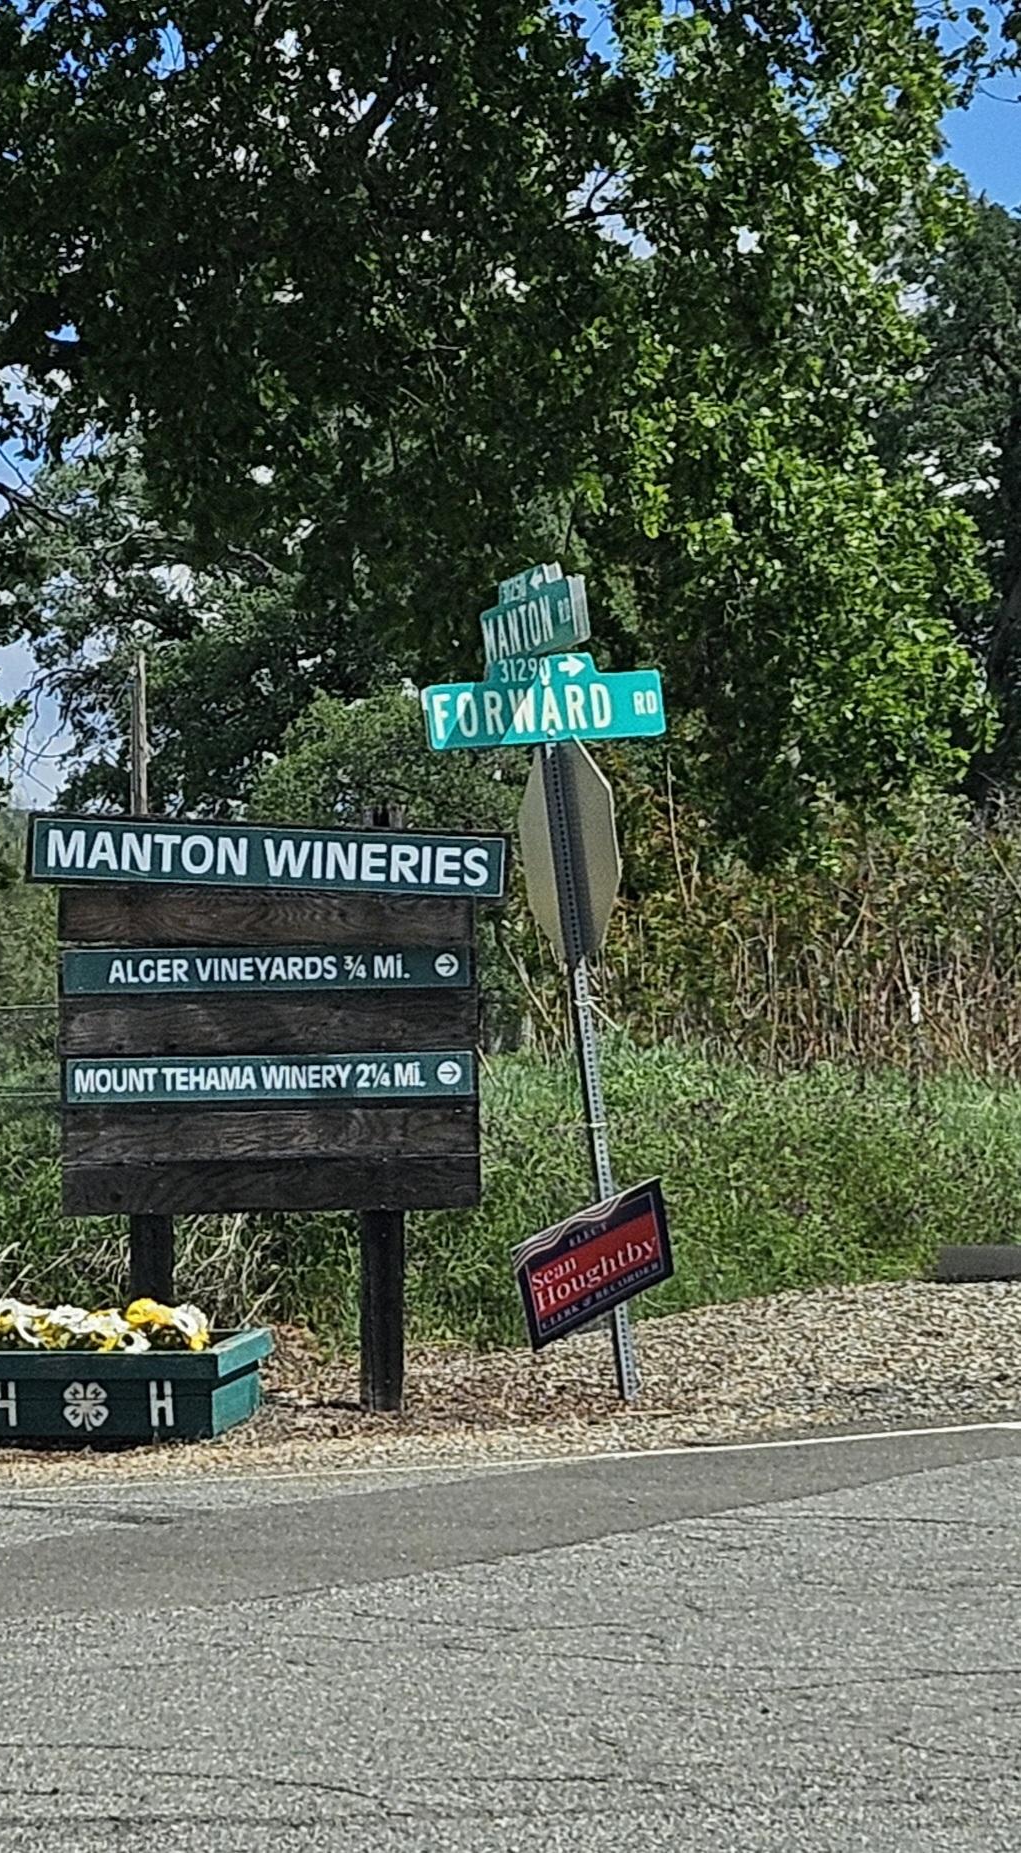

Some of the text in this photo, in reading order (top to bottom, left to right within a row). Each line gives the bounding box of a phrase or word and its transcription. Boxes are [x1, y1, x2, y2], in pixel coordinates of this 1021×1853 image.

[482, 596, 554, 663] MANTON
[432, 683, 658, 740] FORWARD RD
[46, 828, 490, 888] MANTON WINERIES
[108, 957, 190, 985] ALGER
[195, 954, 338, 982] VINEYARDS
[73, 1066, 159, 1095] MOUNT
[161, 1065, 258, 1092] TEHAMA
[260, 1063, 353, 1092] WINERY
[530, 1256, 578, 1292] Sean
[533, 1237, 657, 1312] Houghtby
[149, 1380, 174, 1427] H
